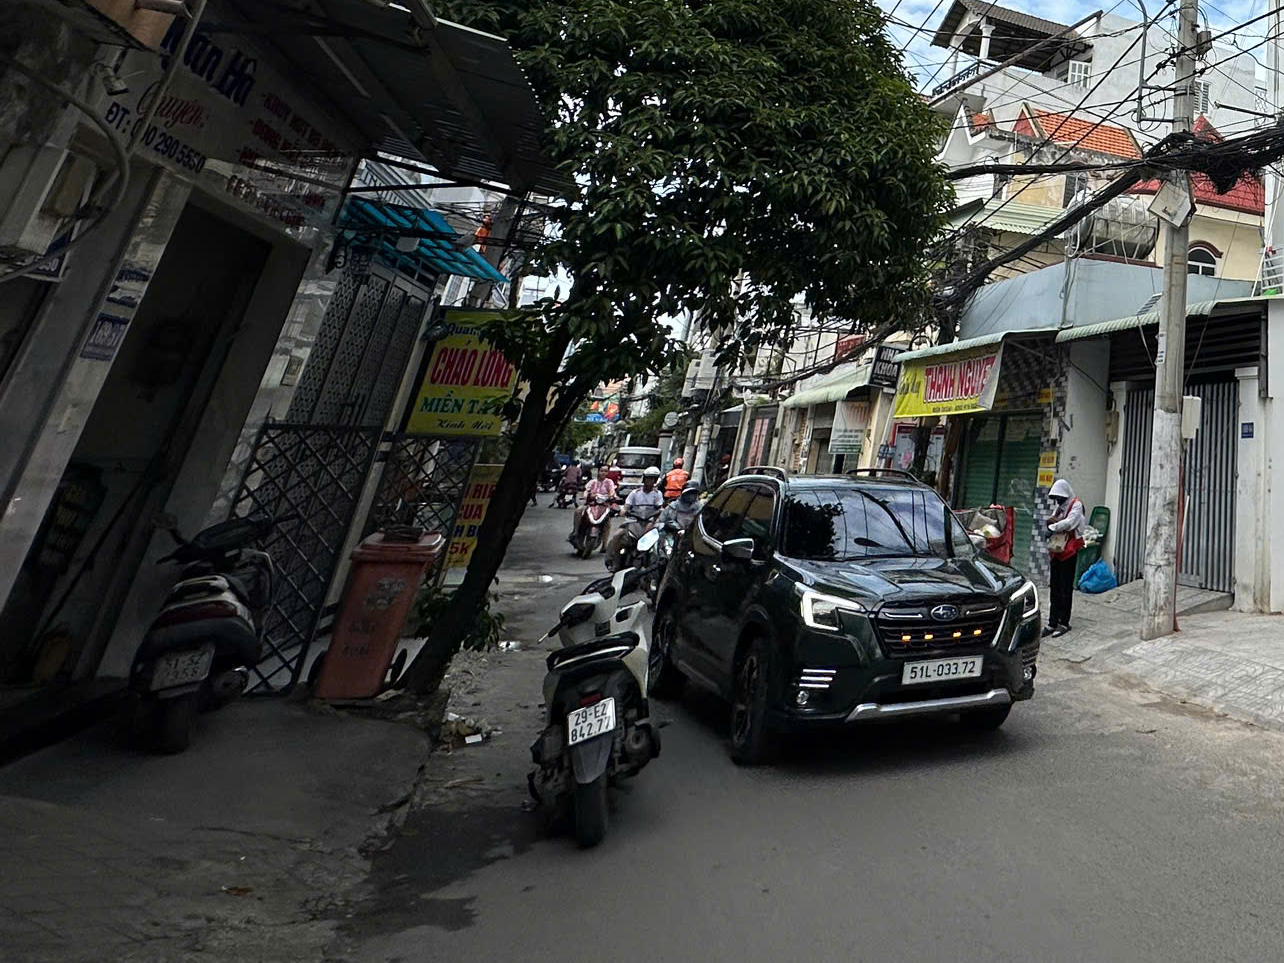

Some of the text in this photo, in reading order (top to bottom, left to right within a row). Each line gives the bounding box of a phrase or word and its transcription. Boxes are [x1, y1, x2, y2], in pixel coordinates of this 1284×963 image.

[431, 340, 478, 386] CHÁO
[874, 361, 898, 377] KHOA
[924, 363, 956, 402] THANH
[420, 389, 464, 413] MIỀN
[449, 542, 472, 554] 5k
[910, 661, 976, 679] 51L-033.72
[575, 703, 607, 726] 29-E2
[571, 717, 611, 742] 842.77
